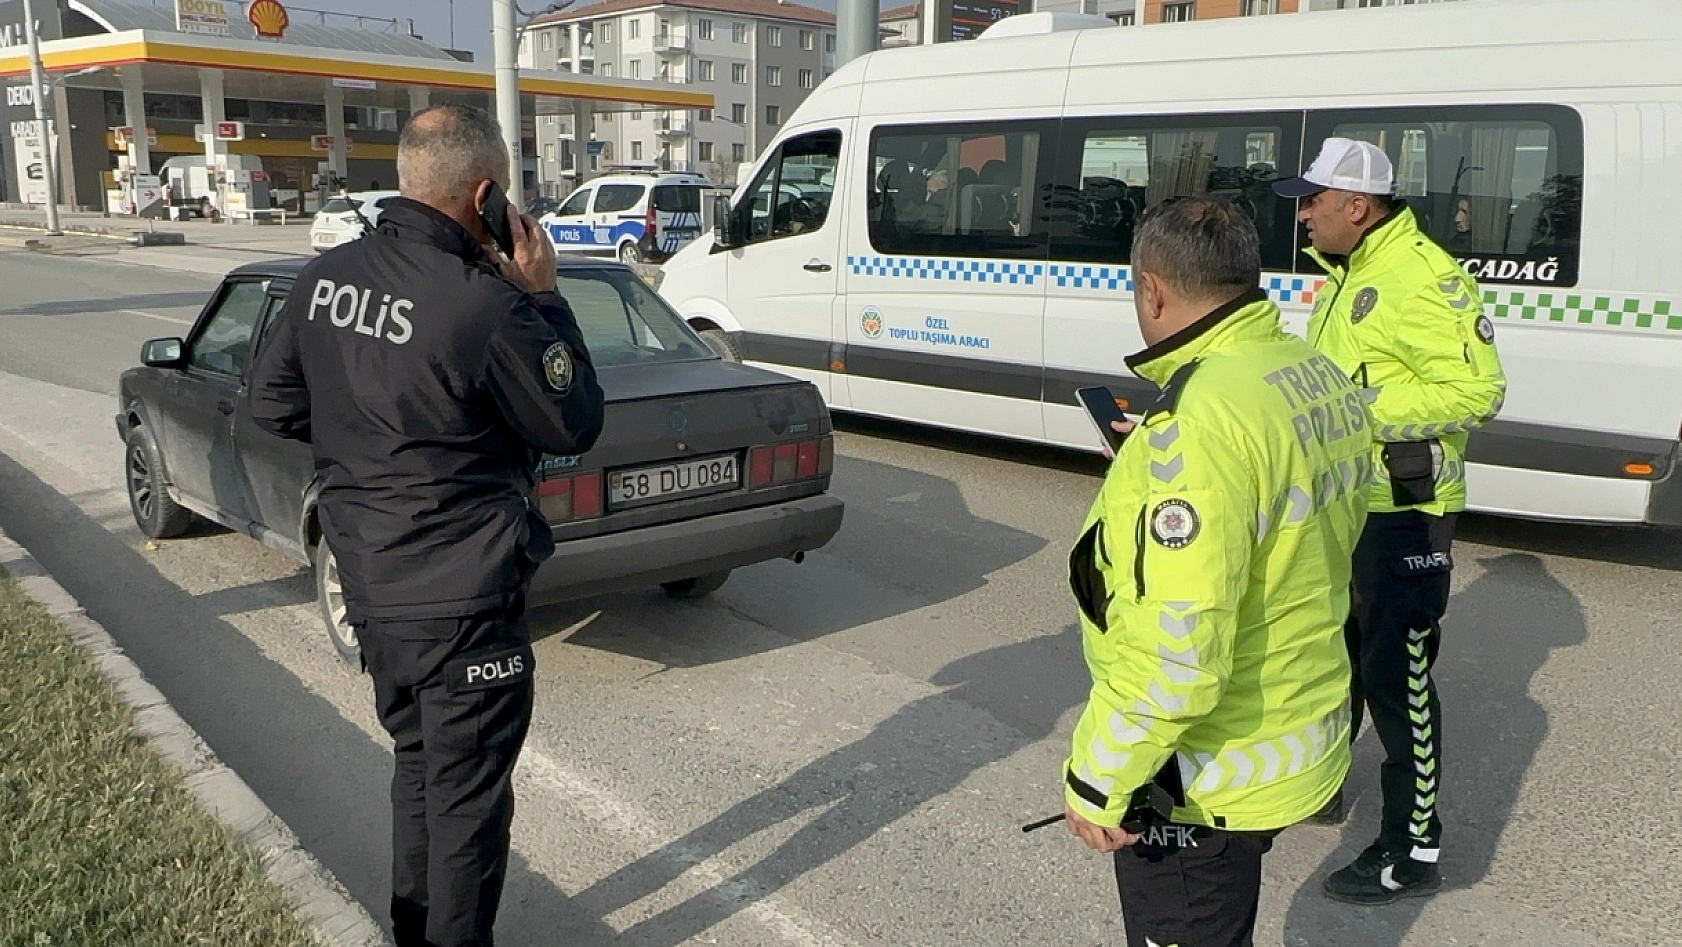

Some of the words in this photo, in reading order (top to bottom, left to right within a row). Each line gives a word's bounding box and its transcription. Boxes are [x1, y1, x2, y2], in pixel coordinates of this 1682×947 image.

[560, 228, 581, 241] POLİS
[307, 278, 415, 345] POLİS
[925, 315, 950, 331] ÖZEL
[888, 328, 918, 341] TOPLU
[919, 331, 957, 346] TAŞIMA
[958, 335, 990, 349] ARACI
[622, 474, 649, 499] 58
[661, 466, 692, 492] DU
[697, 459, 734, 487] 084
[466, 655, 525, 684] POLİS
[1140, 826, 1199, 848] AFİK
